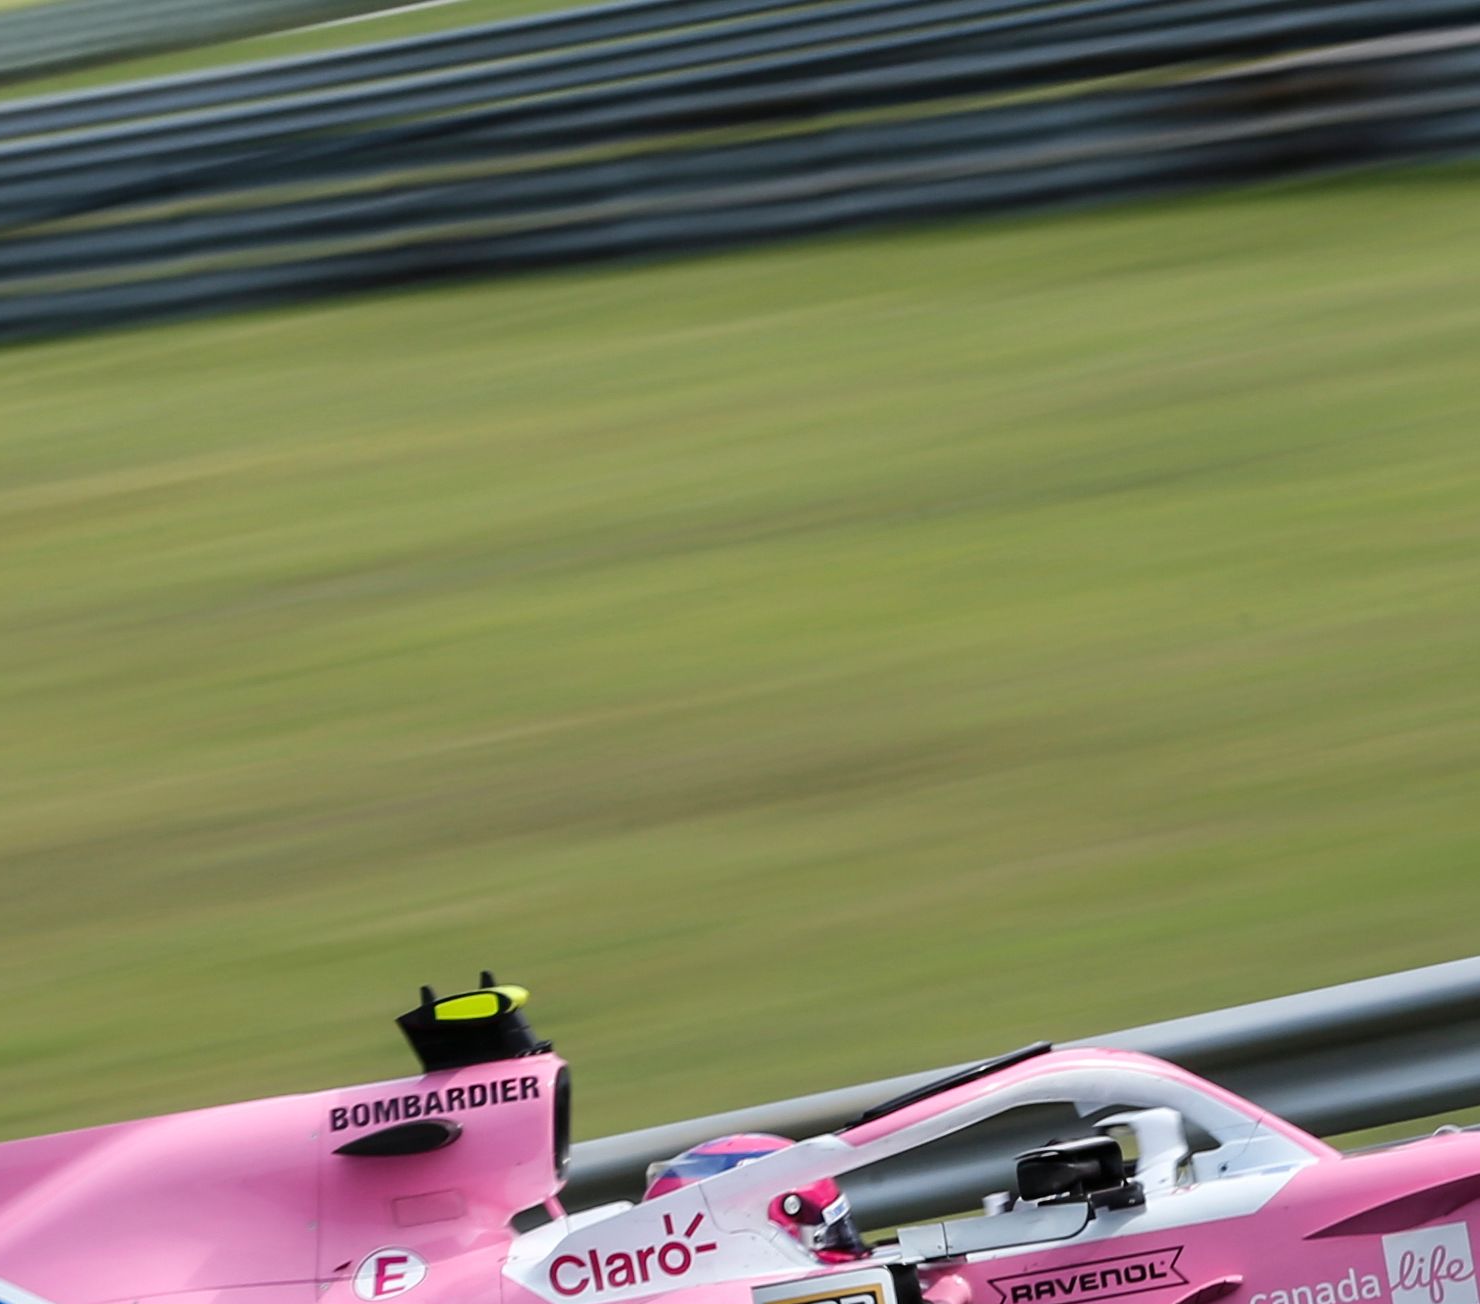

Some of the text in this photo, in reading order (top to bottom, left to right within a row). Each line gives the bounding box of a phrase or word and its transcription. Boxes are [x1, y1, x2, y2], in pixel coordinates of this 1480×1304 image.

[330, 1076, 540, 1132] BOMBARDIER
[374, 1255, 408, 1297] E
[550, 1241, 692, 1296] Claro
[1010, 1261, 1167, 1304] RAVENOL
[1390, 1245, 1475, 1304] life
